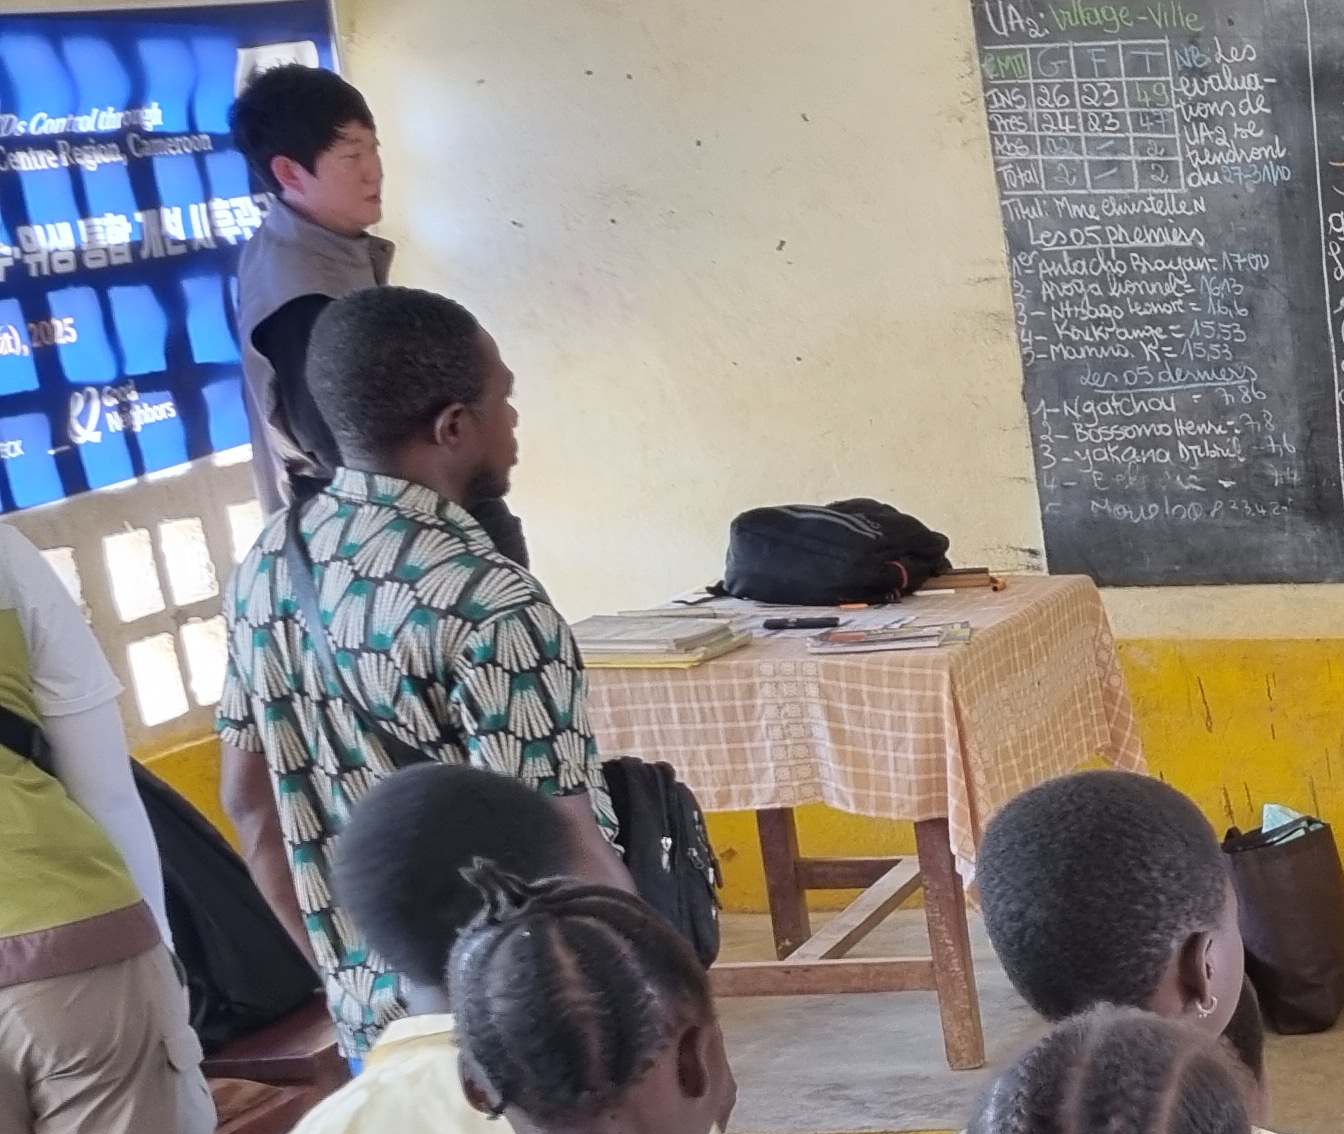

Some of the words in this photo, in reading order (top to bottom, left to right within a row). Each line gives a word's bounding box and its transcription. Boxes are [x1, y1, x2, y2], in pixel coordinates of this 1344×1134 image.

[1087, 48, 1106, 78] F
[1130, 50, 1164, 74] T
[1214, 36, 1257, 63] Les
[986, 86, 1027, 110] INS
[1037, 84, 1070, 108] 26
[1081, 82, 1119, 107] 23
[1135, 80, 1169, 108] 49
[29, 107, 98, 136] Control
[98, 101, 163, 132] through
[1042, 113, 1076, 134] 24
[126, 133, 213, 157] Cameroon
[1054, 163, 1077, 186] 2
[1151, 163, 1169, 185] 2
[1187, 165, 1222, 188] du
[1027, 220, 1067, 247] Les
[1068, 225, 1102, 247] 05
[28, 316, 78, 348] 2025
[105, 401, 177, 432] Neighbors
